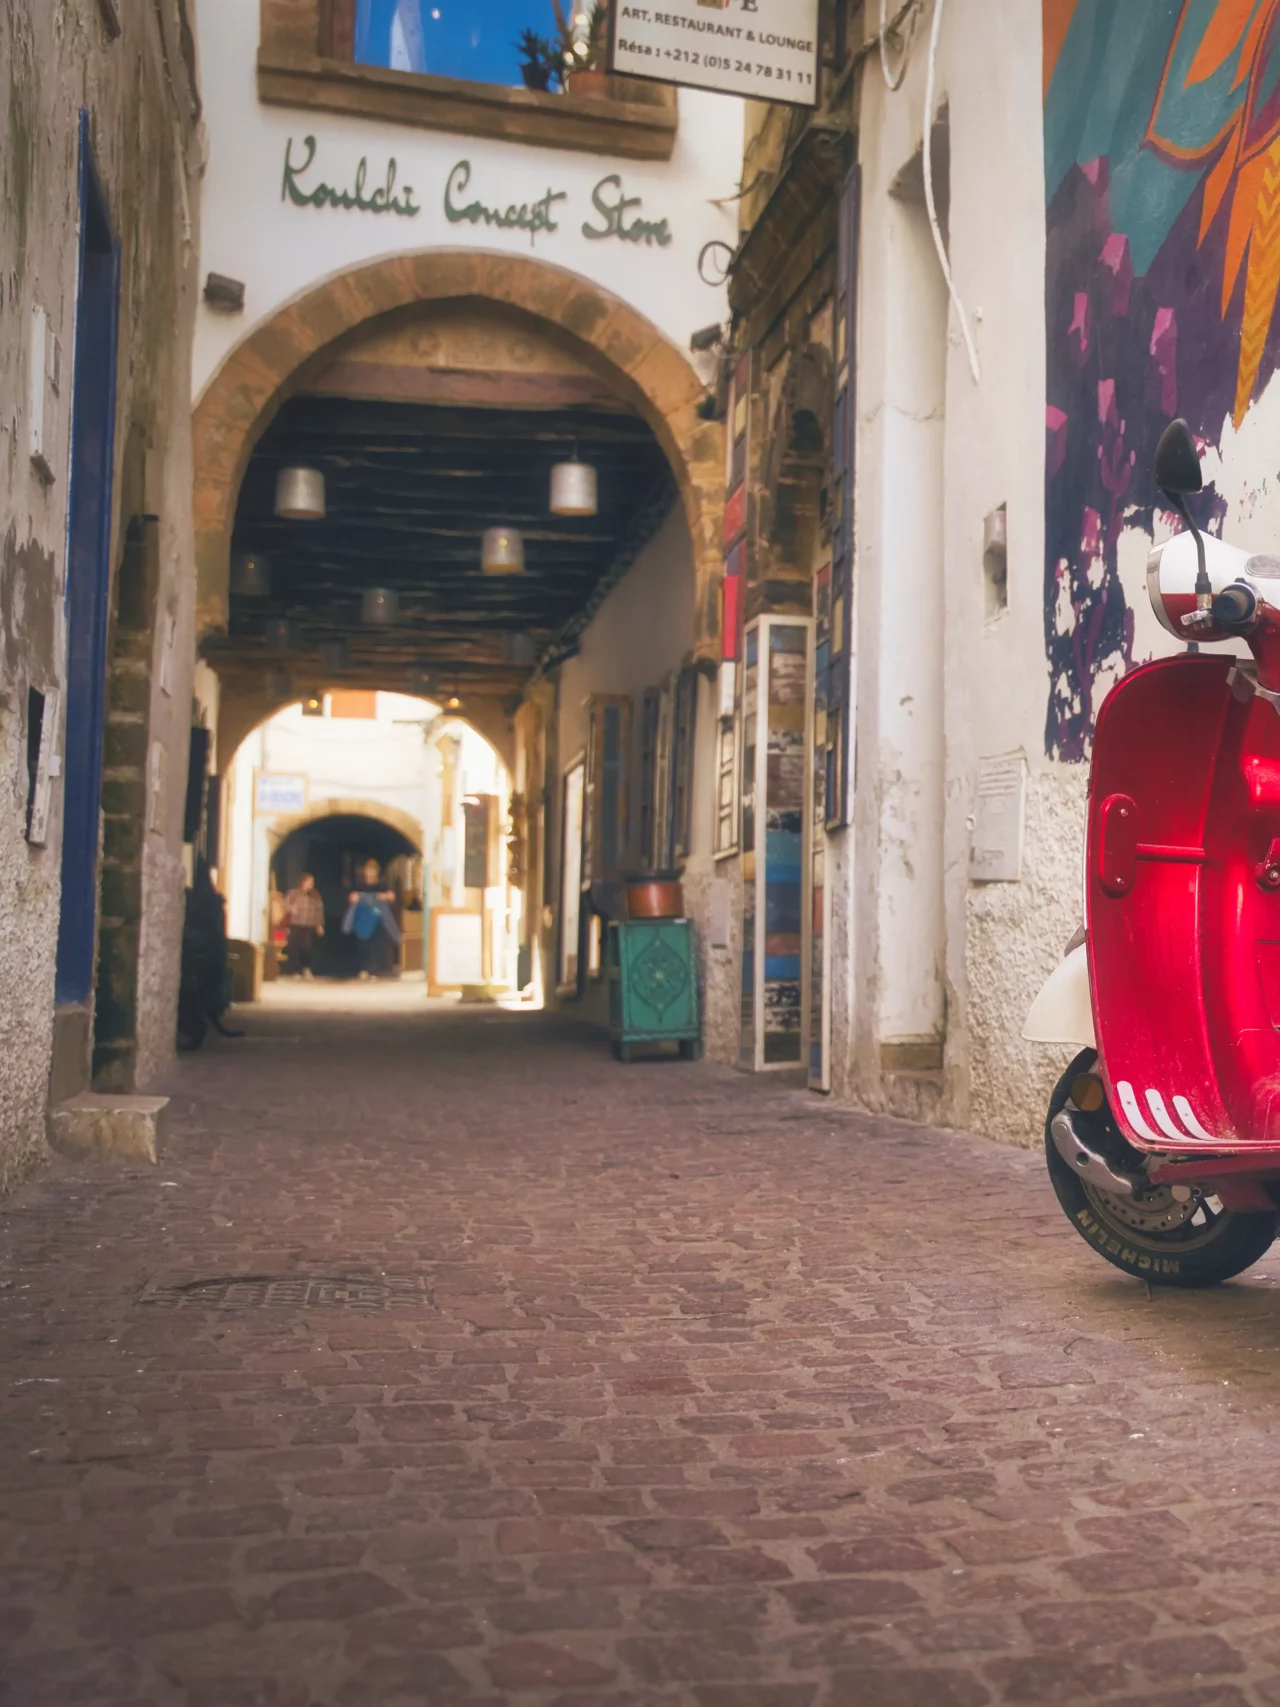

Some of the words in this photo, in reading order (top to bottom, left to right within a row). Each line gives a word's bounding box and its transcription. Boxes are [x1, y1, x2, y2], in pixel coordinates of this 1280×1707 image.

[621, 6, 651, 24] ART,
[654, 13, 744, 40] RESTAURANT
[746, 30, 756, 42] &
[759, 32, 814, 53] LOUNGE
[618, 38, 652, 57] Résa
[663, 49, 700, 65] +212
[703, 54, 731, 71] (0)5
[735, 60, 752, 74] 24
[756, 64, 772, 78] 78
[776, 67, 792, 82] 31
[797, 71, 813, 85] 11
[443, 159, 567, 247] Concept
[581, 173, 673, 247] Store
[1076, 1209, 1181, 1274] MICHELIN
